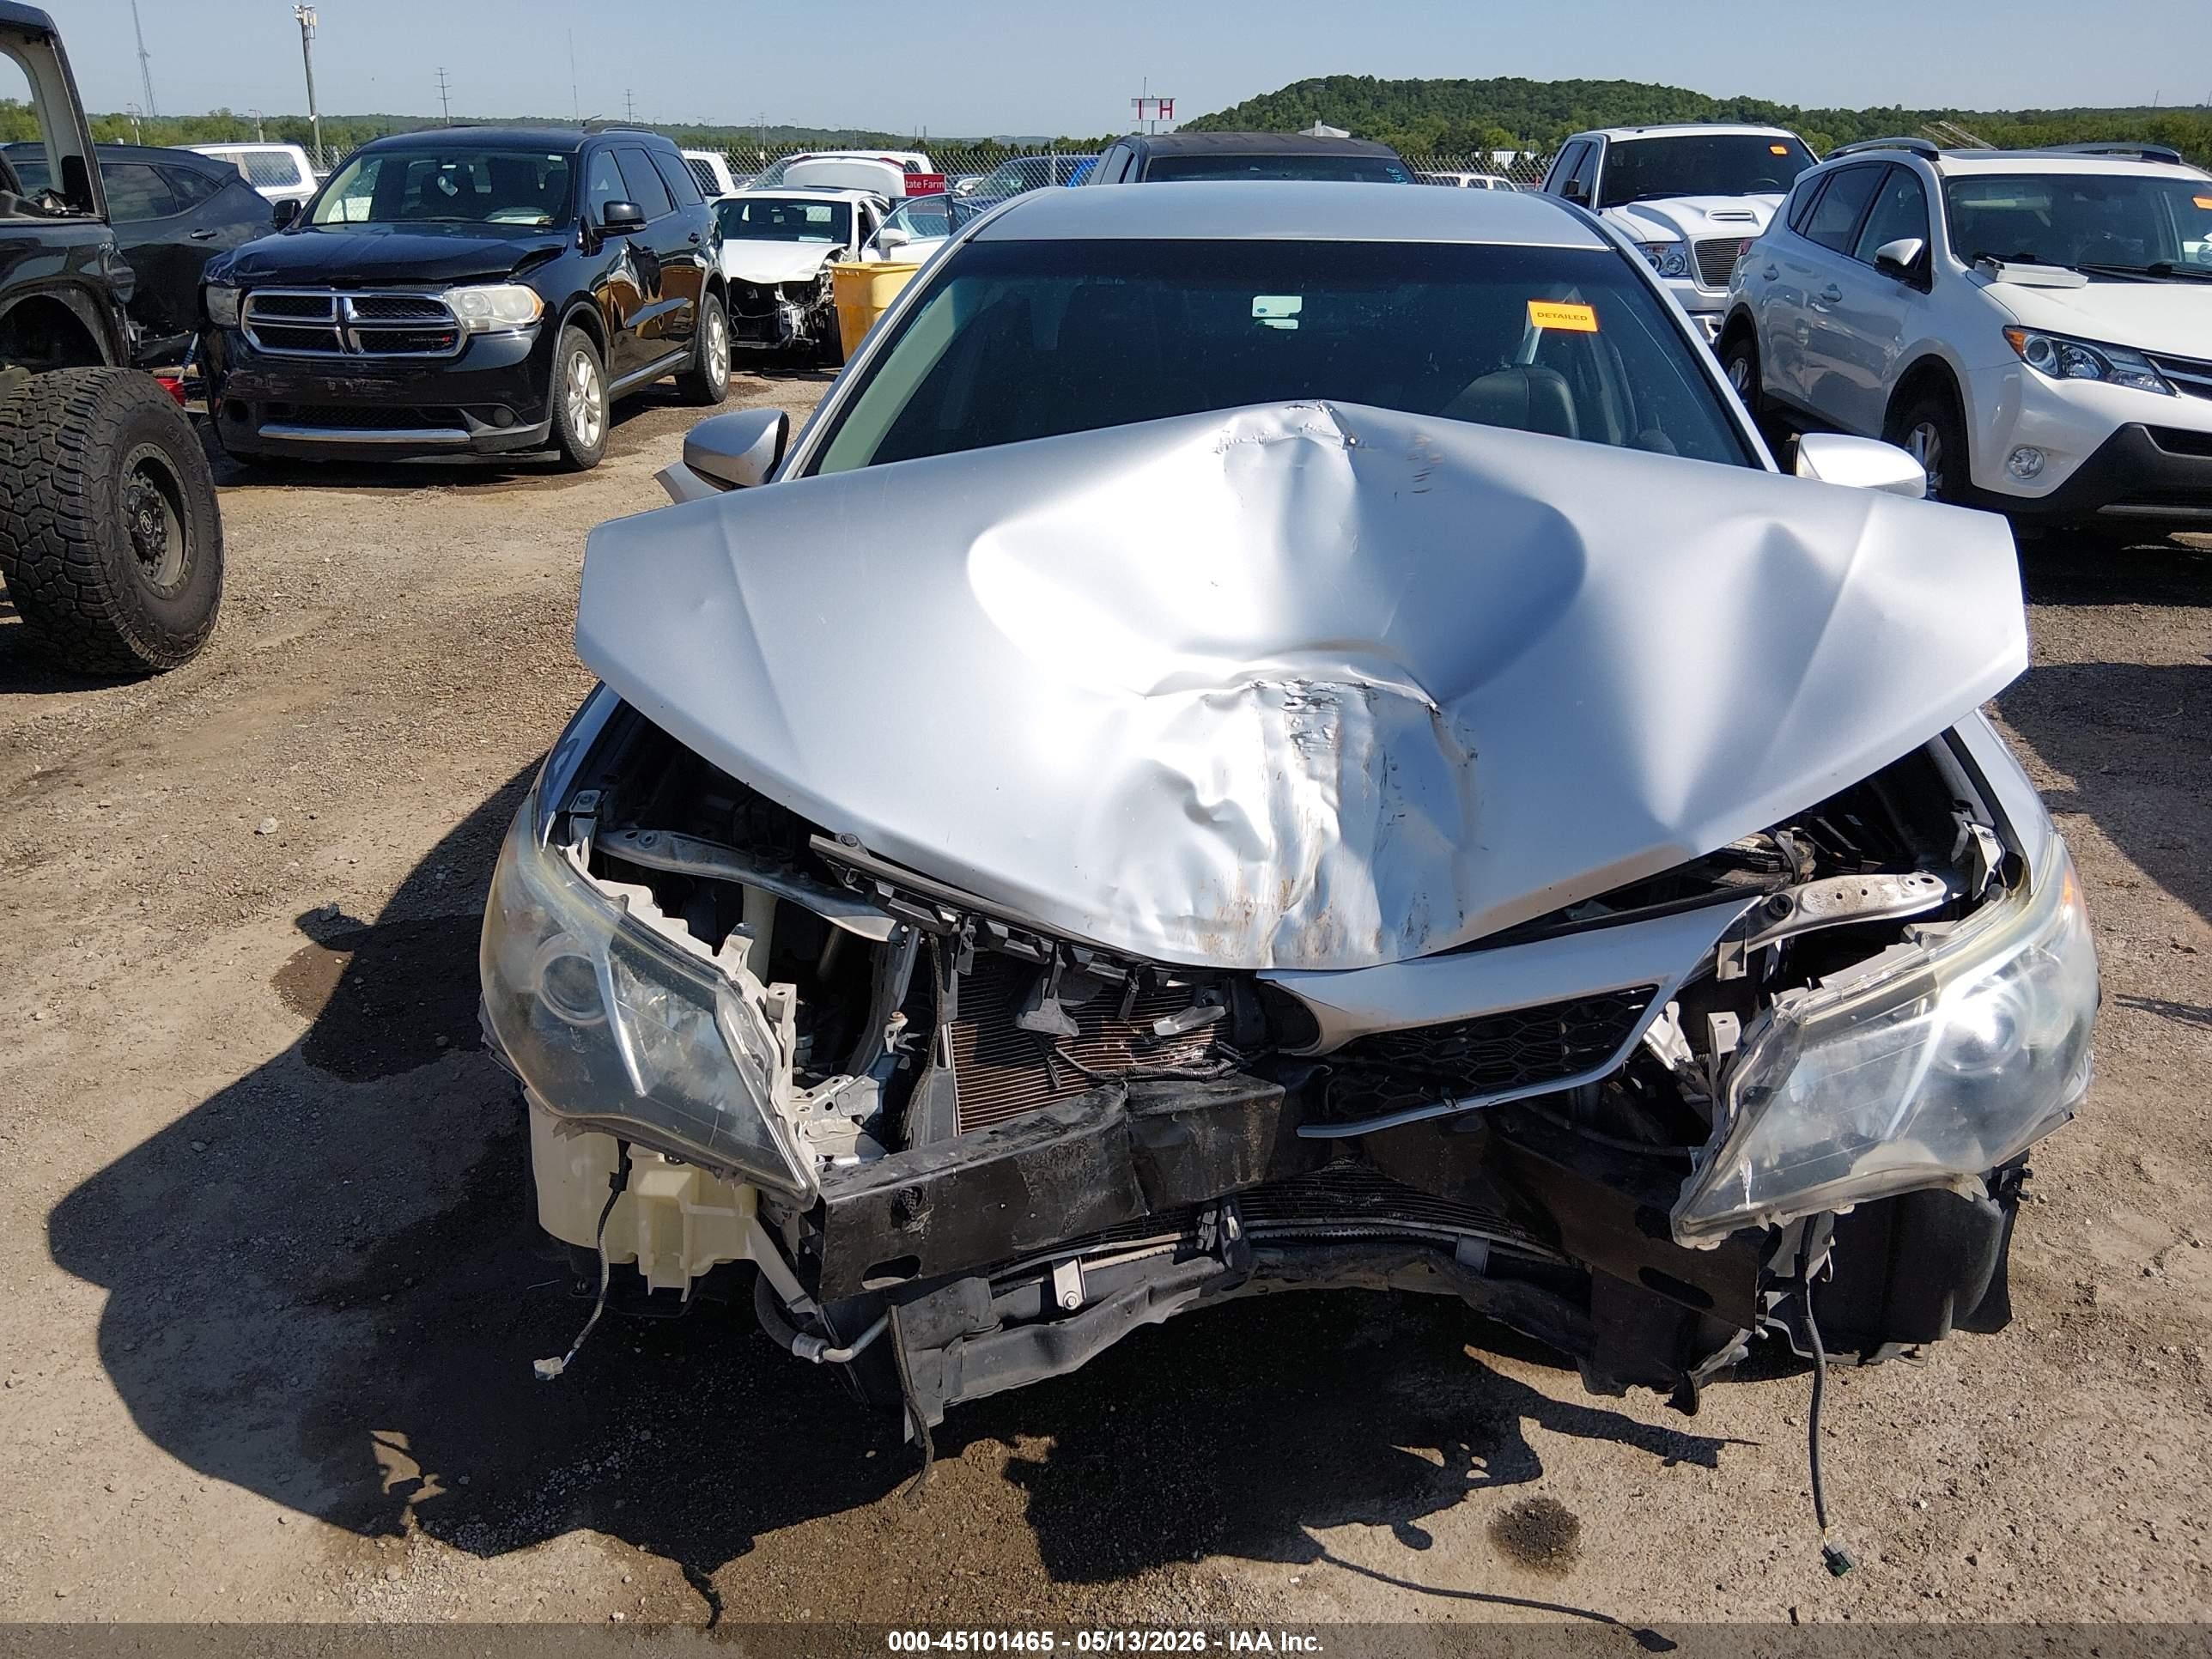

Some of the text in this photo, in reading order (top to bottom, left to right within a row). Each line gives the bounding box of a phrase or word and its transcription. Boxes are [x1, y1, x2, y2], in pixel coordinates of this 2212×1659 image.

[905, 179, 945, 189] tate Farm
[1536, 312, 1588, 321] DETAILED
